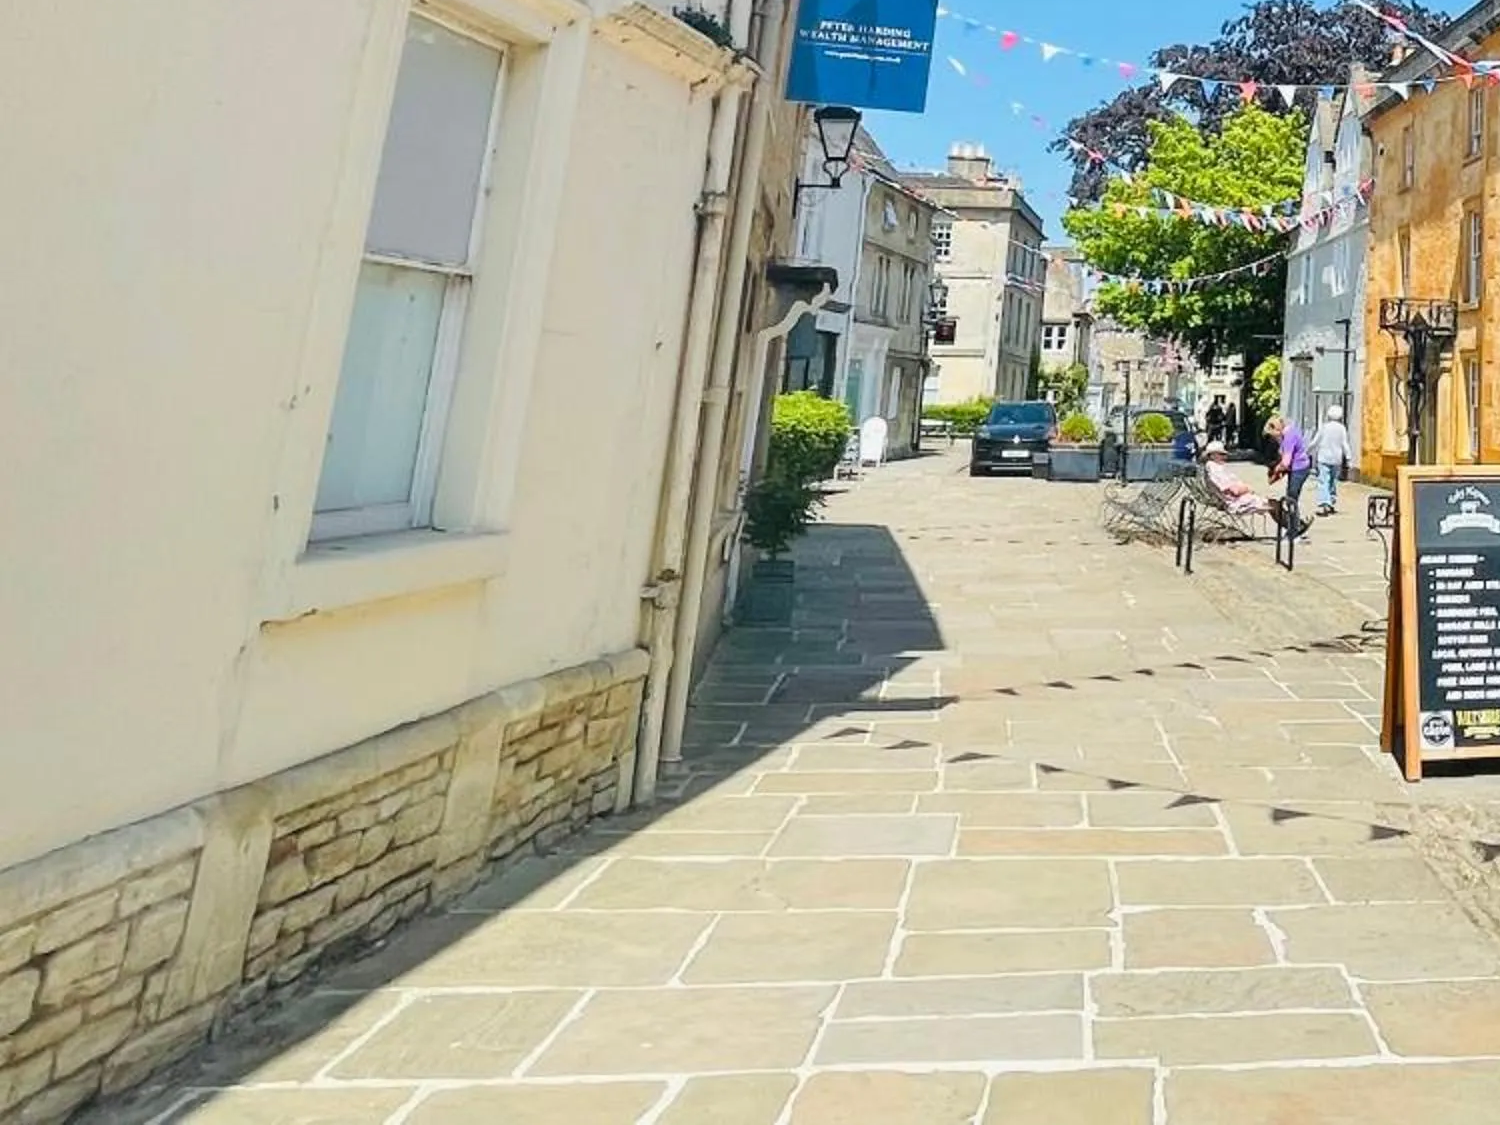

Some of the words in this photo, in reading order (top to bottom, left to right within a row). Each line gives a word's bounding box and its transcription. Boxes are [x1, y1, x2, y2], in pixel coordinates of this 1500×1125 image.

[799, 28, 847, 43] WEALTH
[850, 33, 931, 51] MANAGEMENT
[820, 20, 855, 32] PETER
[859, 24, 912, 39] HARDING
